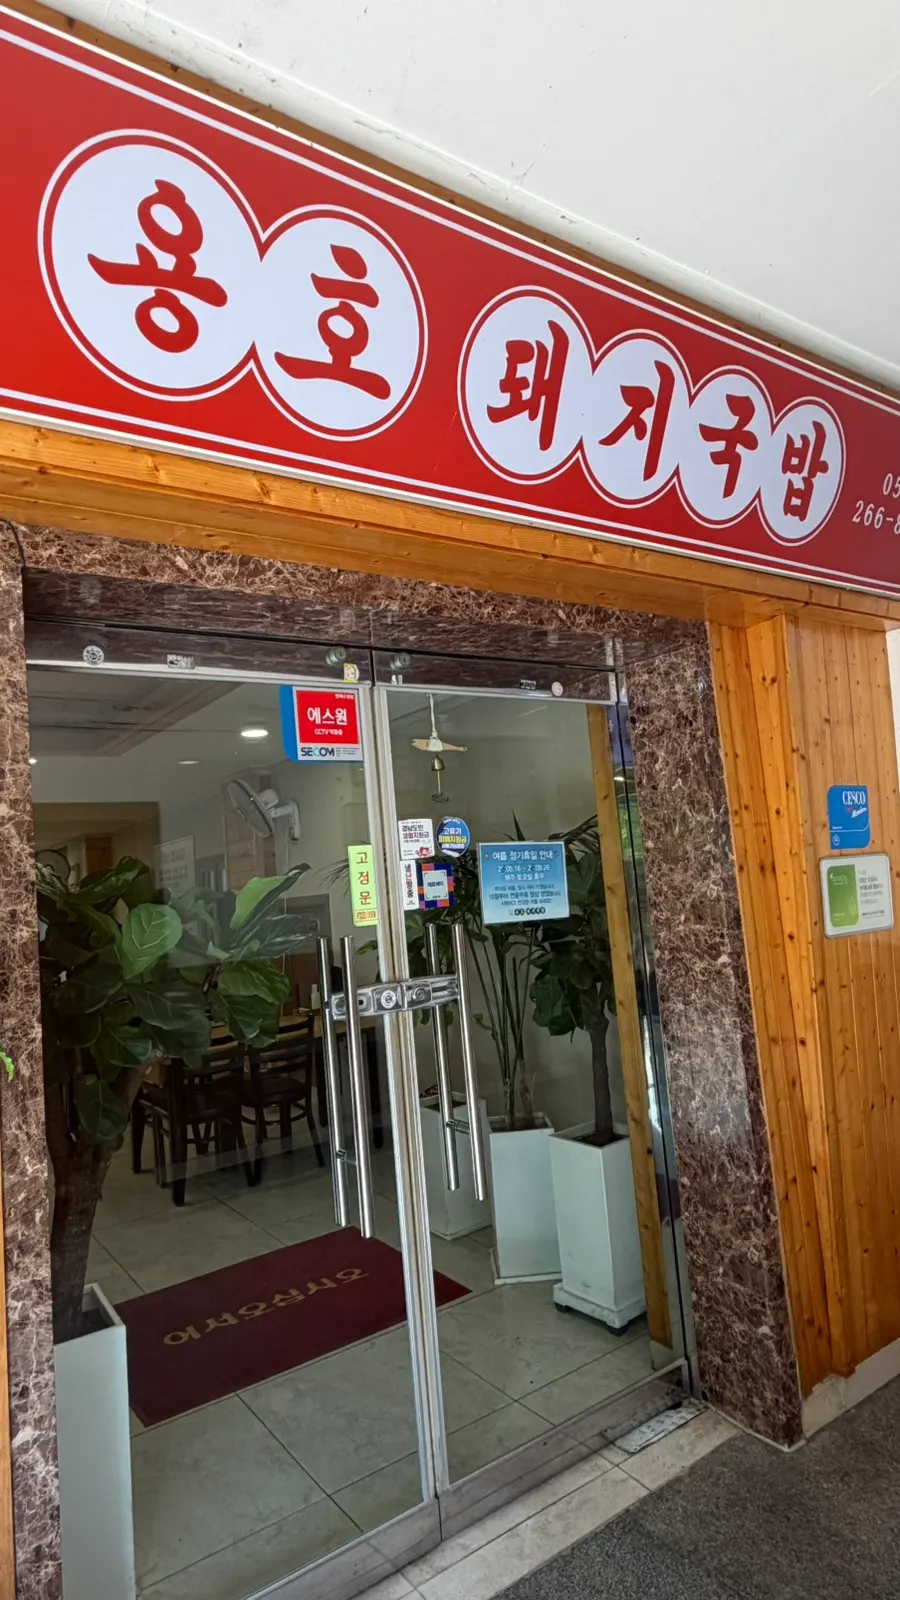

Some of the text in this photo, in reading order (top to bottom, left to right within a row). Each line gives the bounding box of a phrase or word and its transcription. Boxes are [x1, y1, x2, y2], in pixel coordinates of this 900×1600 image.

[87, 179, 829, 522] 용호 돼지국밥
[307, 707, 348, 726] 에스원
[301, 747, 335, 757] SECOM
[842, 791, 866, 805] CESCO
[438, 835, 466, 843] 피해지원금
[492, 850, 554, 861] 여름 정기휴일 안내
[356, 852, 371, 905] 고정문
[164, 1268, 370, 1345] 어서오십시오
